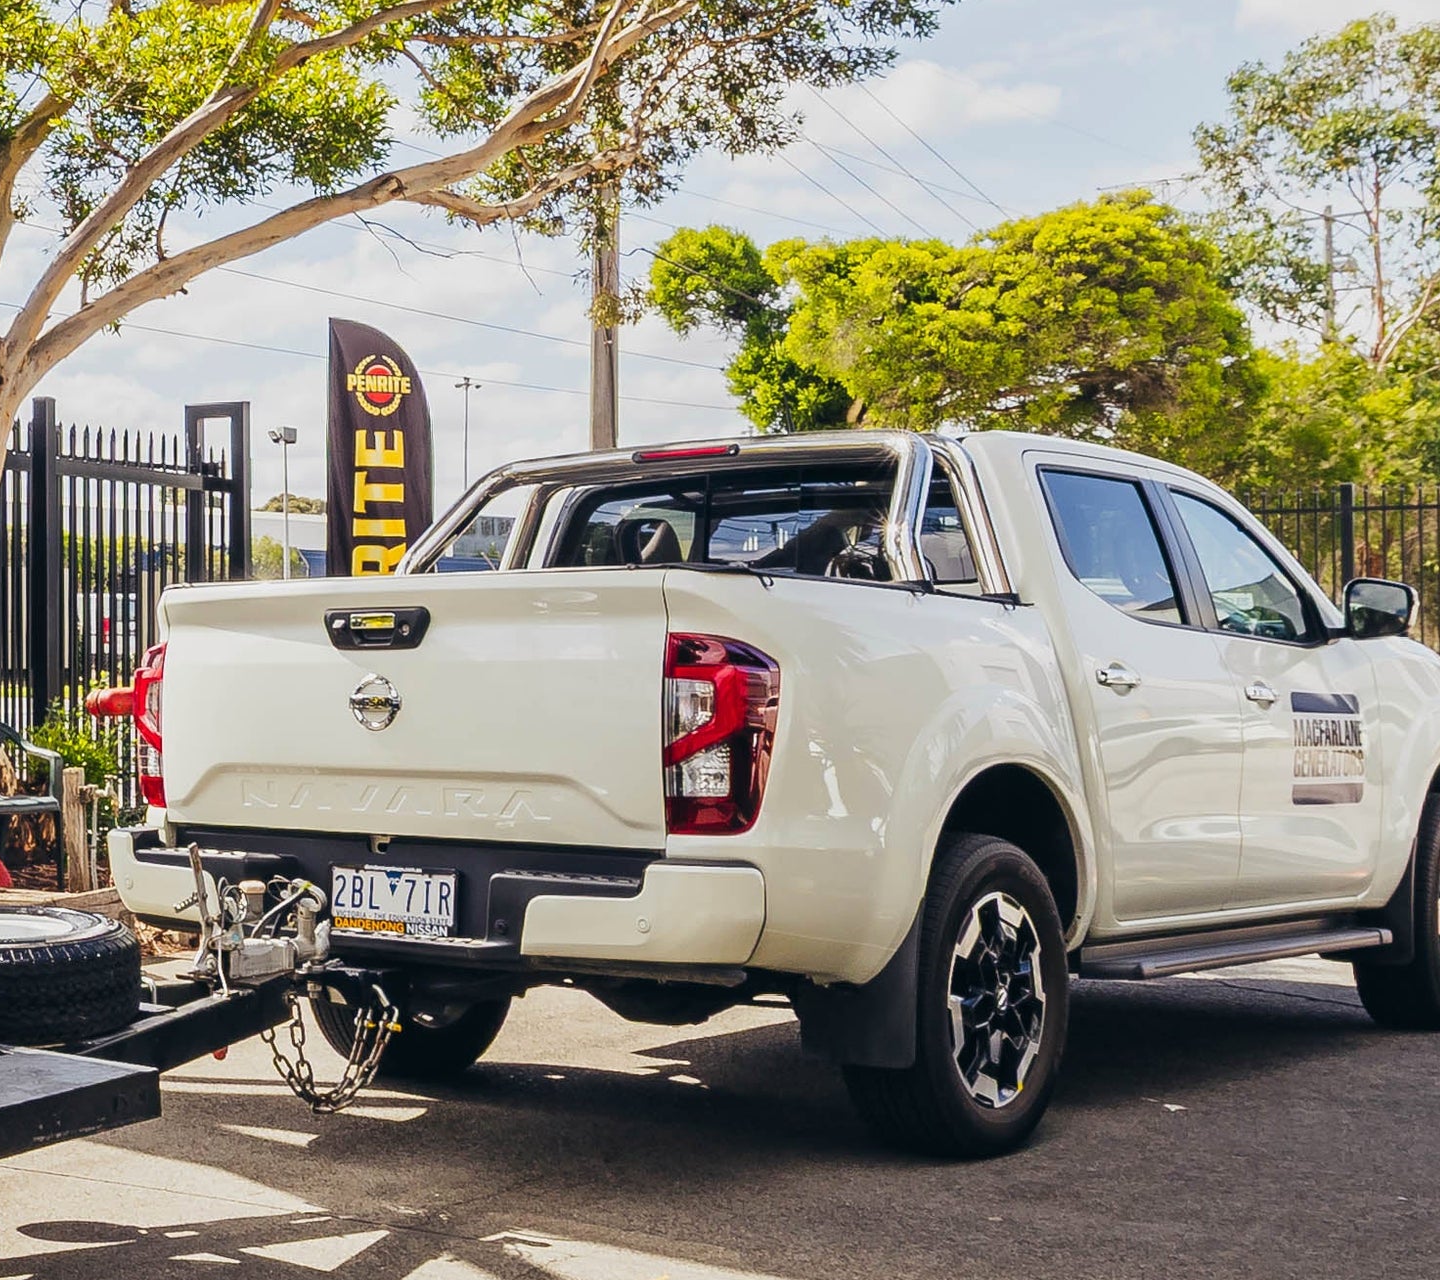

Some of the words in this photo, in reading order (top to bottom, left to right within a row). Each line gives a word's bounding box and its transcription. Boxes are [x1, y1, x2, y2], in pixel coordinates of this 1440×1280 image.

[346, 373, 412, 394] PENRITE
[1292, 719, 1362, 747] MACFARLANE
[1293, 749, 1364, 777] GENERATORS
[241, 779, 551, 820] NAVARA
[334, 874, 380, 910] 2BL
[405, 879, 451, 916] 7IR
[335, 917, 405, 934] DANDENONG
[406, 923, 448, 937] NISSAN
[336, 910, 366, 918] VICTORIA
[389, 914, 427, 923] EDUCATION
[429, 917, 449, 926] STATE
